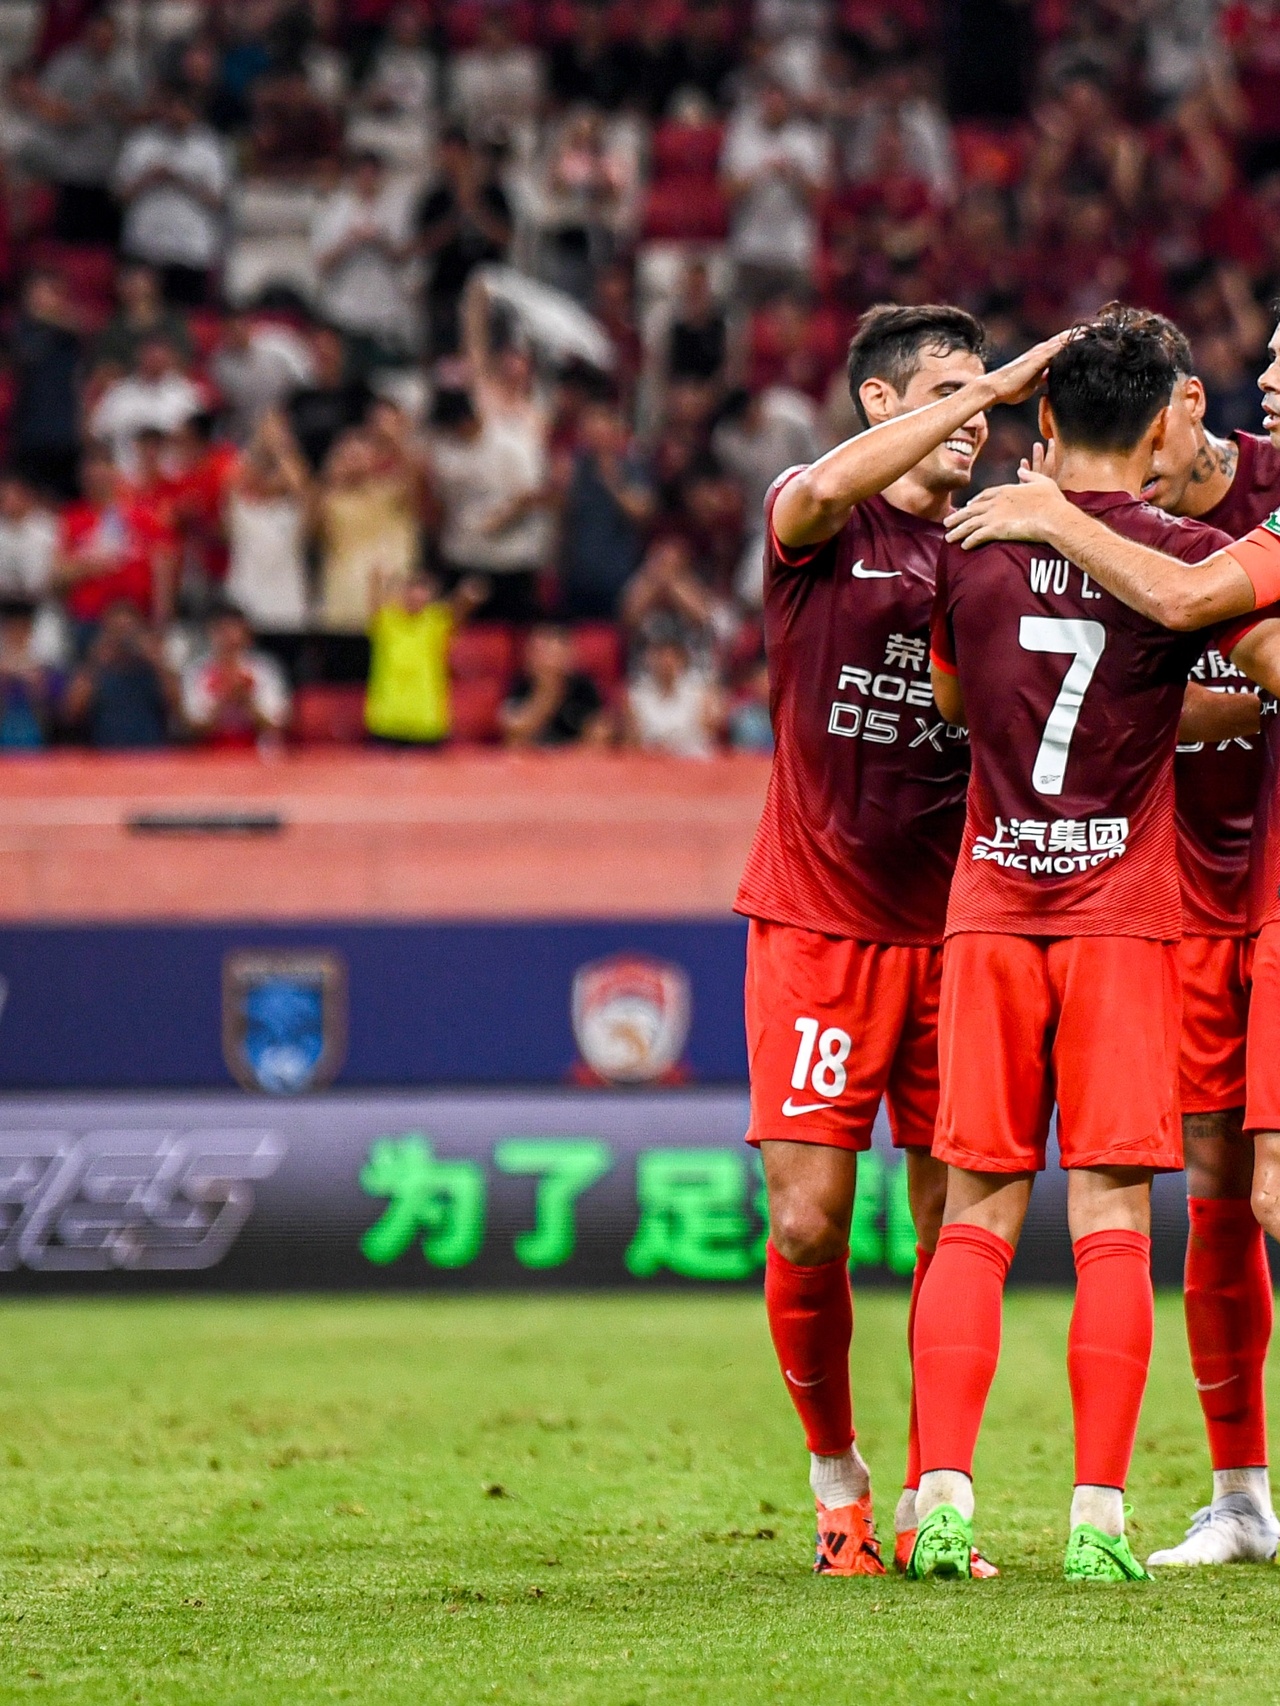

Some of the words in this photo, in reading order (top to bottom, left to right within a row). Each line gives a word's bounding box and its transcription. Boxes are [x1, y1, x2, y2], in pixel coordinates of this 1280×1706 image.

[1030, 558, 1069, 595] WU
[1081, 572, 1101, 599] L.
[883, 633, 931, 672] 荣
[838, 665, 933, 707] ROE
[1018, 615, 1106, 795] 7
[975, 816, 1129, 852] 上汽集团
[972, 845, 1028, 870] SAIC
[1031, 843, 1126, 874] MOTOR
[791, 1016, 852, 1098] 18
[358, 1132, 917, 1280] 为了足
